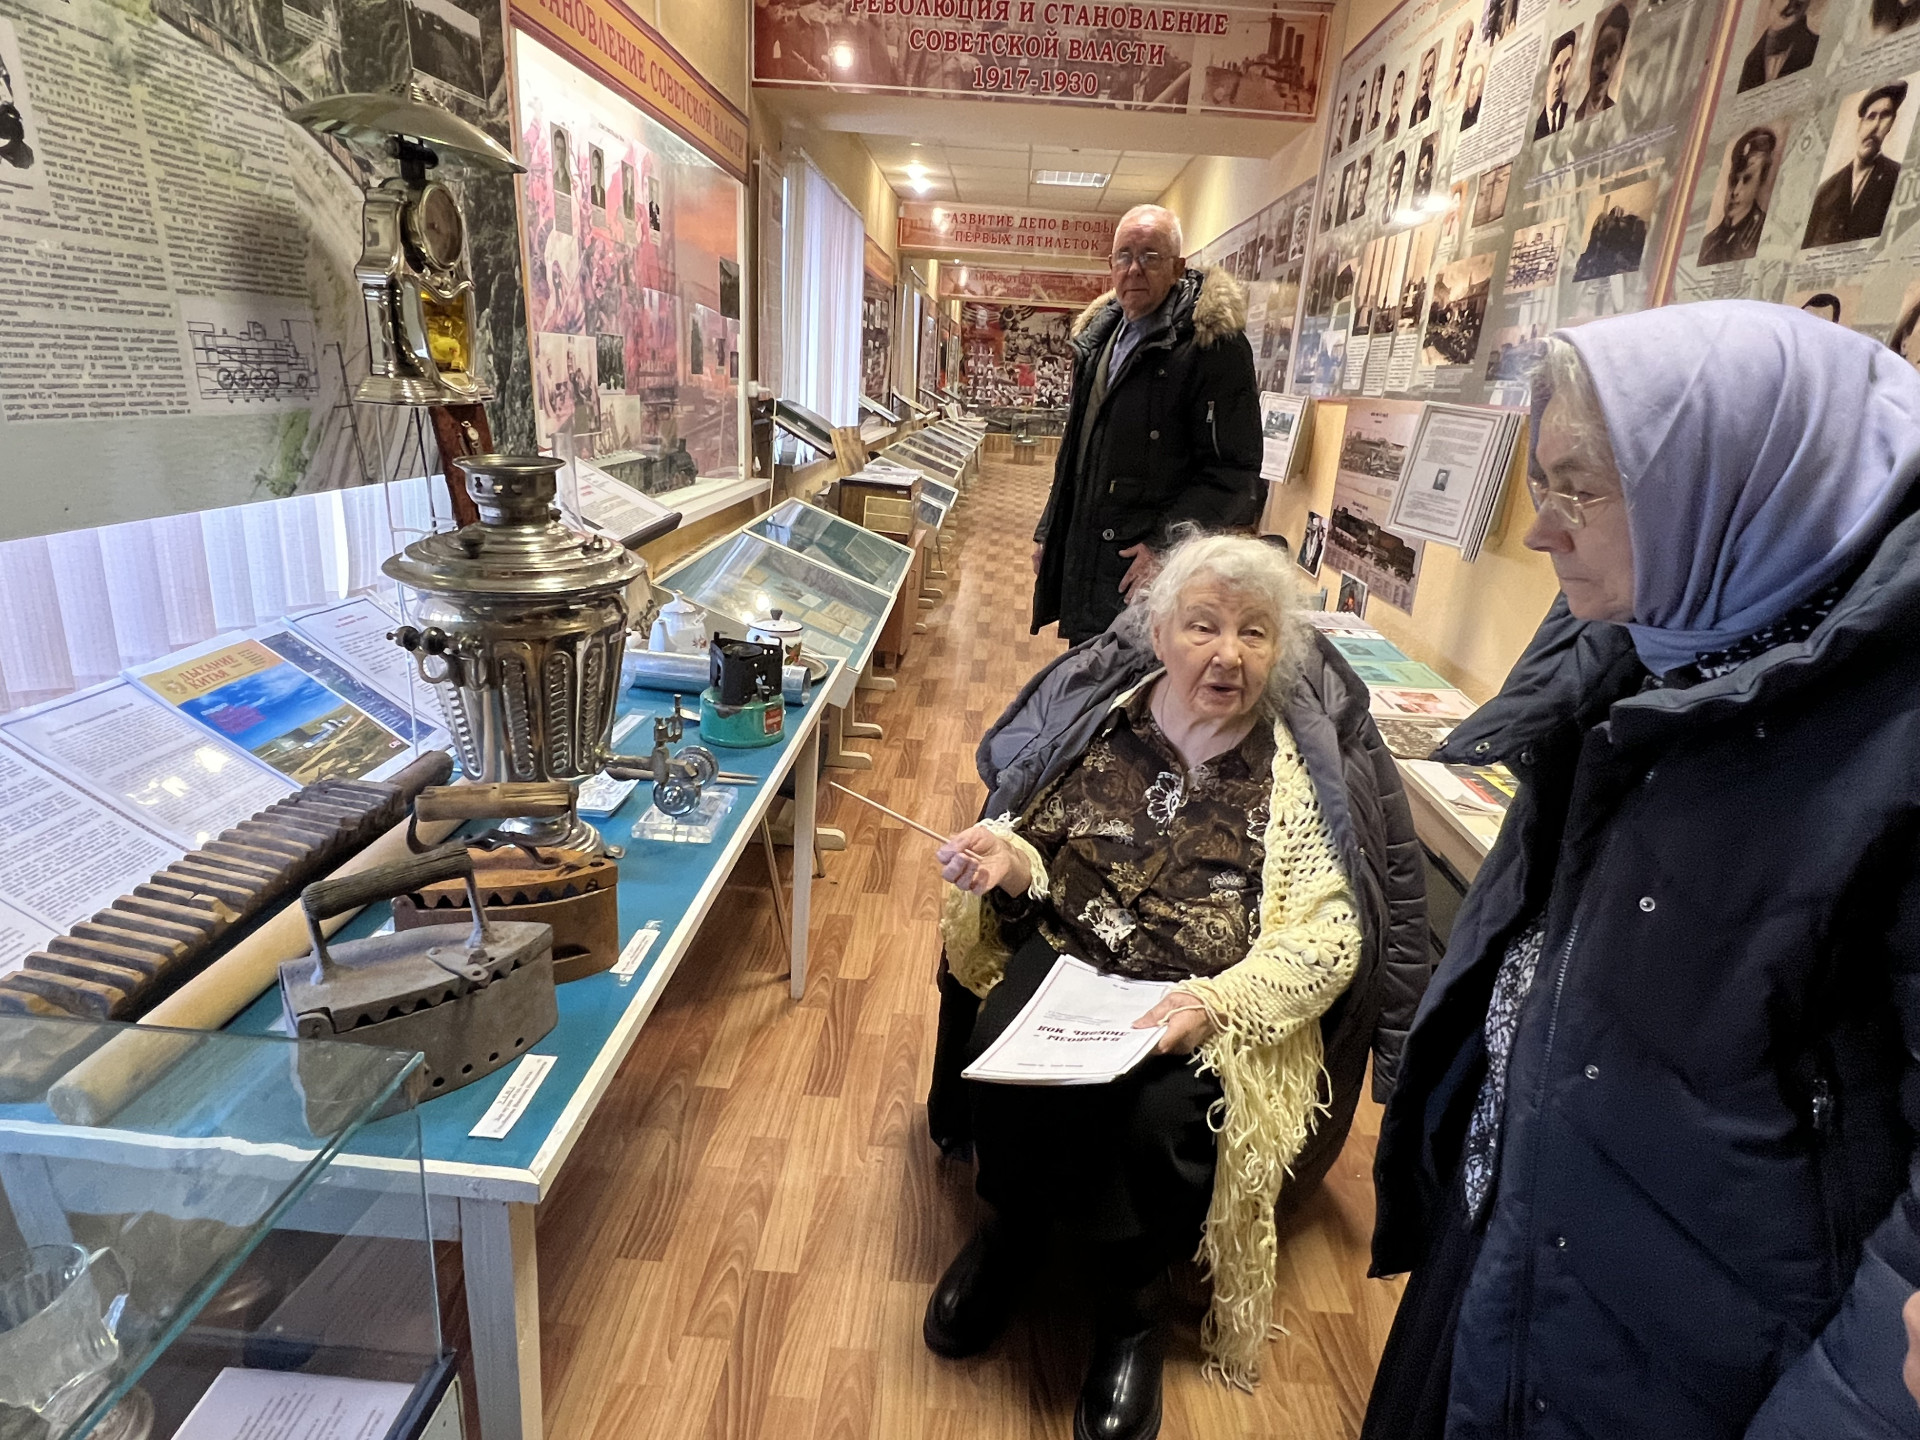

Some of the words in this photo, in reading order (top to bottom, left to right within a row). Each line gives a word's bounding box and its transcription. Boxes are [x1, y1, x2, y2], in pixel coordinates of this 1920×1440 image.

[1019, 2, 1036, 22] И
[1044, 4, 1229, 35] СТАНОВЛЕНИЕ
[909, 29, 1059, 58] СОВЕТСКОЙ
[1067, 39, 1165, 66] ВЛАСТИ
[972, 66, 1098, 95] 1917-1930
[650, 60, 713, 136] СОВЕТСКОЙ
[1019, 216, 1057, 230] ДЕПО
[1061, 220, 1070, 231] В
[1074, 221, 1116, 234] ГОДЫ
[954, 231, 1012, 246] ПЕРВЫХ
[1016, 235, 1100, 251] ПЯТИЛЕТОК
[178, 654, 237, 681] ДЫХАНИЕ
[185, 669, 230, 690] КИТАЯ
